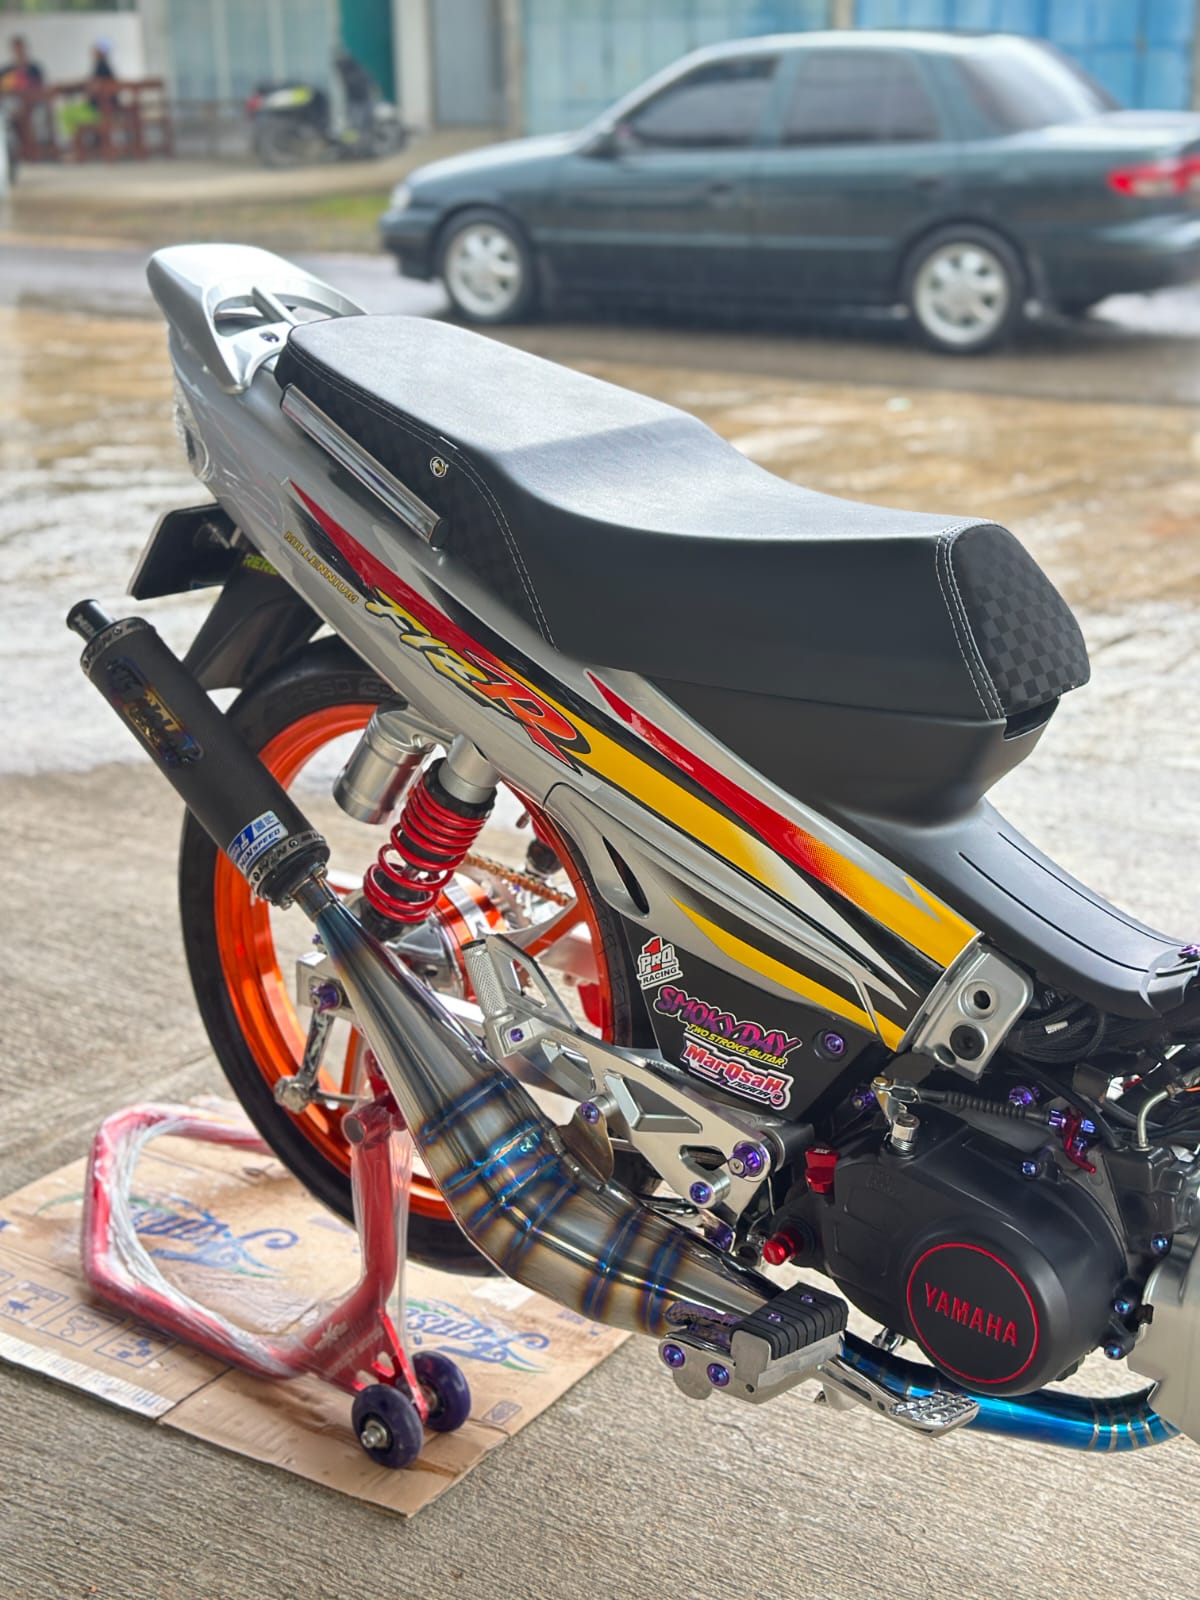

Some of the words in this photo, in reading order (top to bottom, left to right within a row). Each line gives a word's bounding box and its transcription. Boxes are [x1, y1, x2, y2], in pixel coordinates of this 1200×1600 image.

[283, 531, 359, 604] MILLENNIUM
[640, 946, 674, 974] PRO
[643, 967, 678, 984] RACING
[688, 1023, 708, 1040] TWO
[709, 1033, 748, 1055] STROKE
[925, 1282, 1017, 1347] YAMAHA
